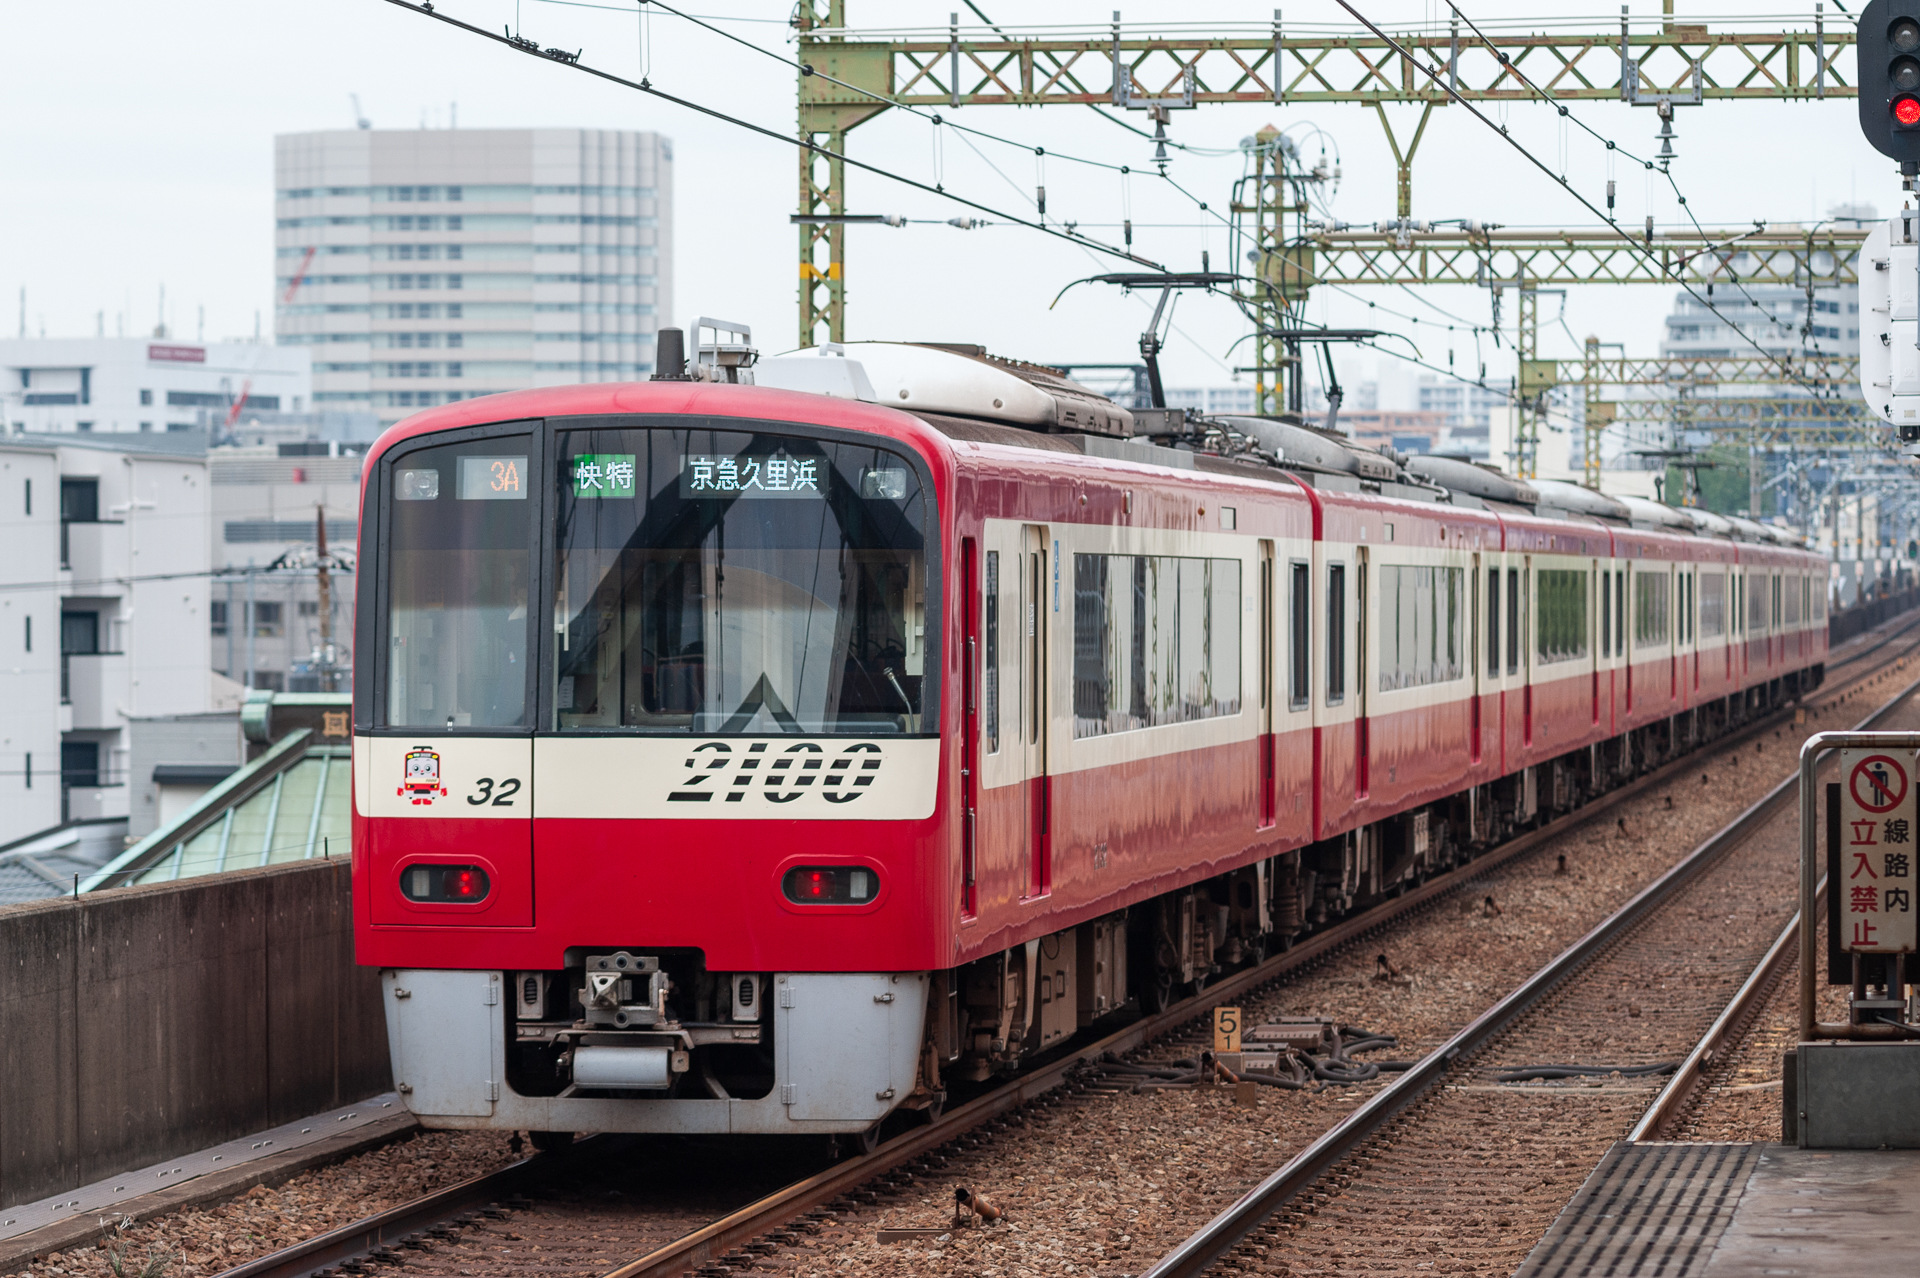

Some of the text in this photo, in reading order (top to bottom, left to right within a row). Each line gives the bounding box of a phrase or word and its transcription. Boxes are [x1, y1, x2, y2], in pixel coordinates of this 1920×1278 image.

[490, 461, 519, 492] 3A
[576, 461, 633, 490] 快特
[690, 457, 818, 491] 京急久里浜
[666, 742, 882, 803] 2100
[467, 778, 521, 806] 32
[1884, 818, 1909, 912] 線路内
[1850, 818, 1878, 946] 立入禁止
[1219, 1011, 1237, 1033] 5
[1223, 1035, 1230, 1049] 1
